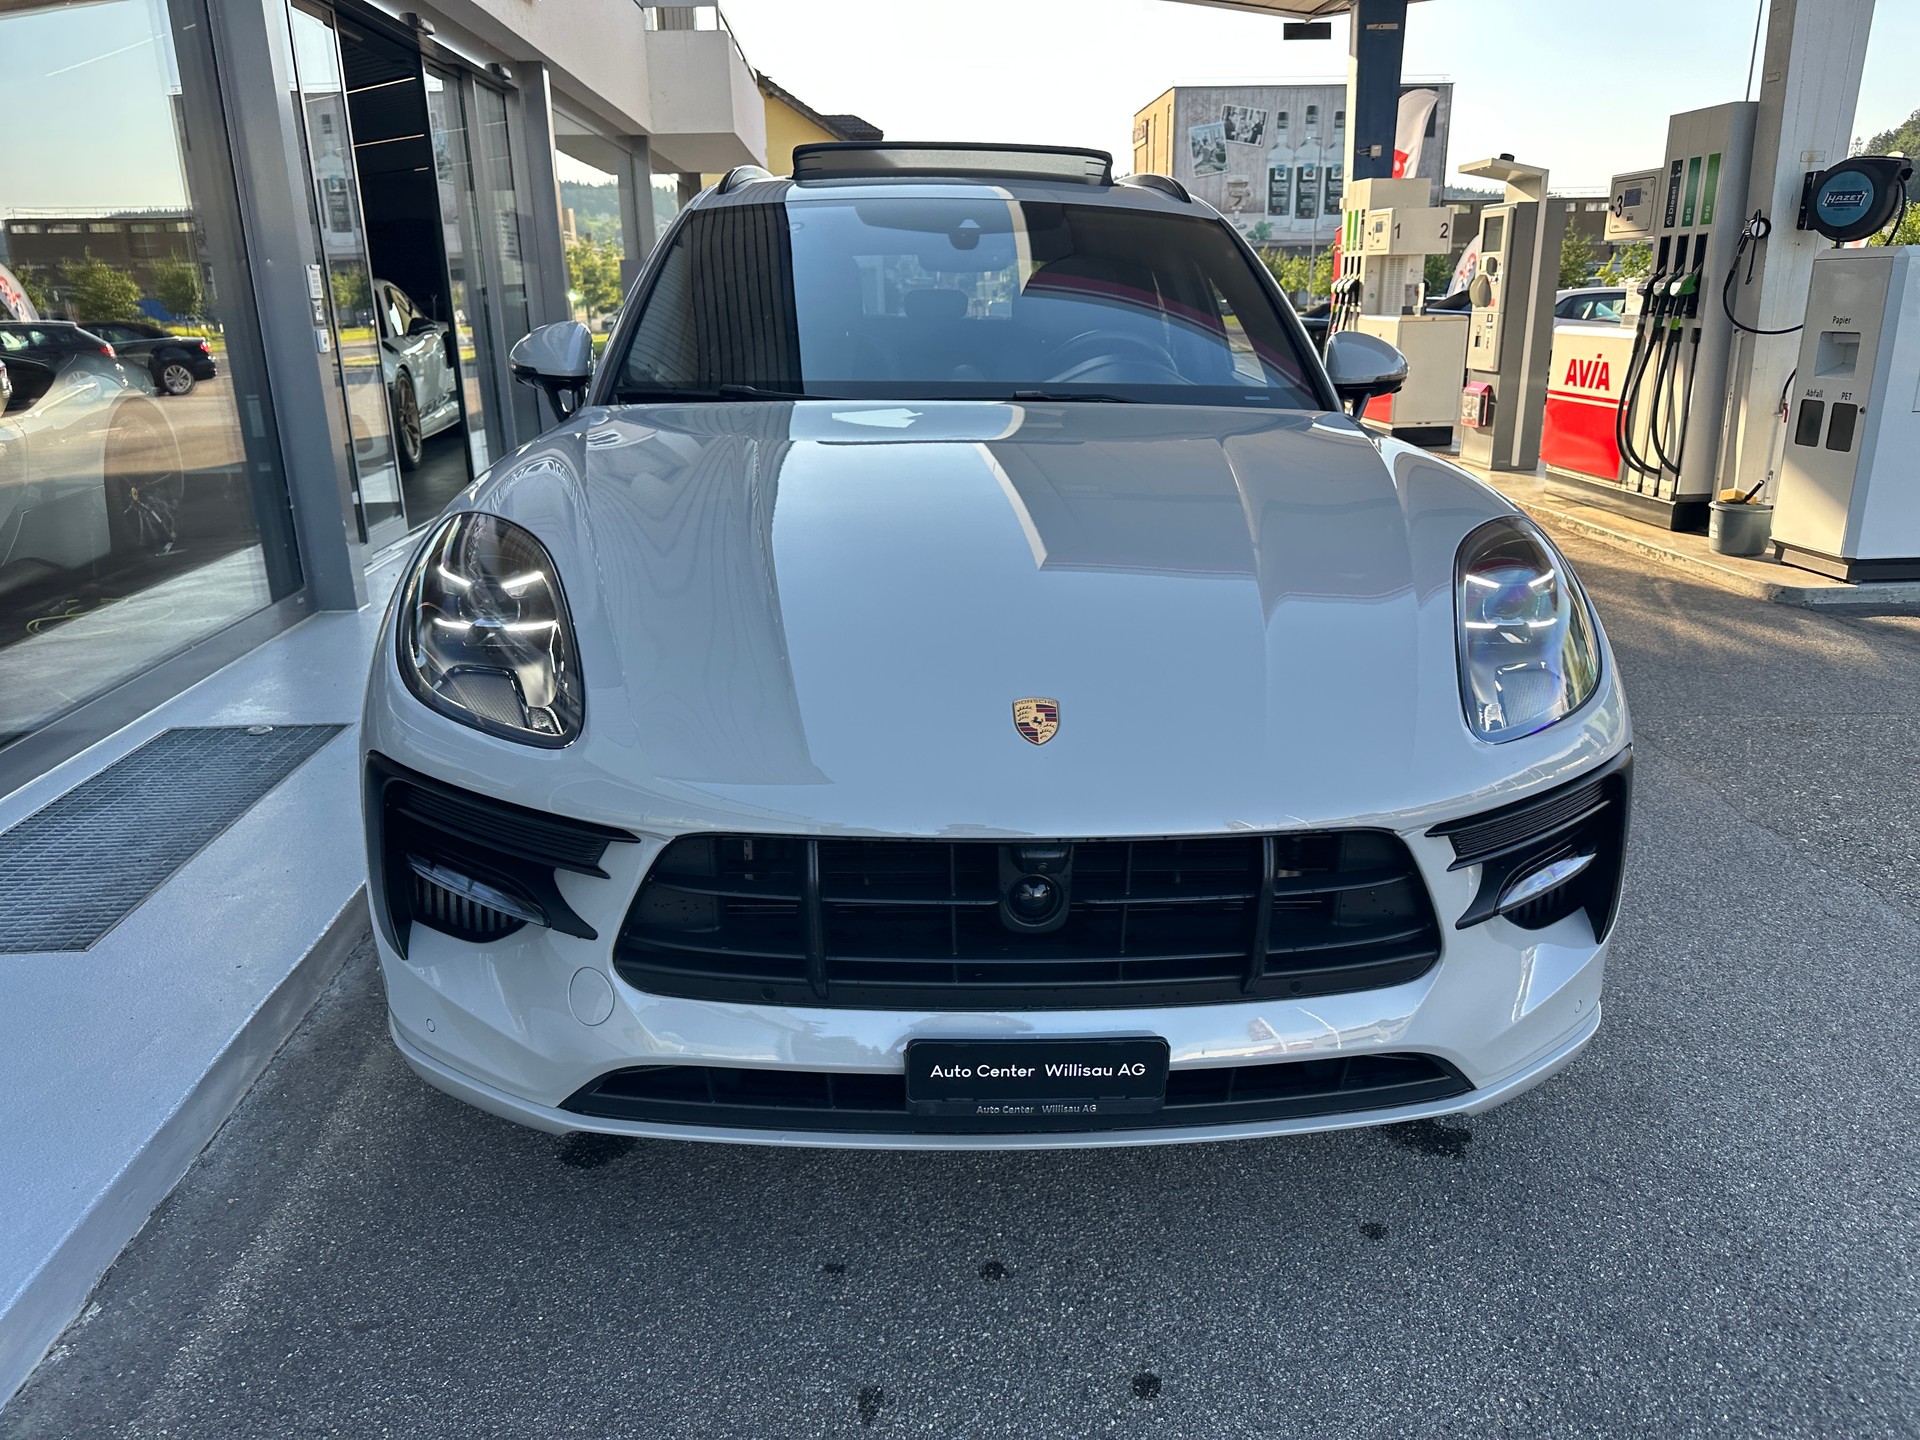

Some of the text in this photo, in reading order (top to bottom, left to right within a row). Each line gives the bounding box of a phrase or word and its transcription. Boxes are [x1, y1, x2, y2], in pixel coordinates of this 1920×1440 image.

[1668, 186, 1677, 215] Diesel
[1826, 194, 1863, 204] HAZET
[1615, 195, 1623, 218] 3
[1394, 223, 1401, 239] 1
[1439, 222, 1449, 239] 2
[1831, 315, 1852, 326] Papier
[1805, 388, 1824, 398] Abfall
[1840, 391, 1853, 401] PET
[930, 1063, 1146, 1078] Auto Center Willisau AG
[976, 1104, 1097, 1114] Auto Center Willisau AG
